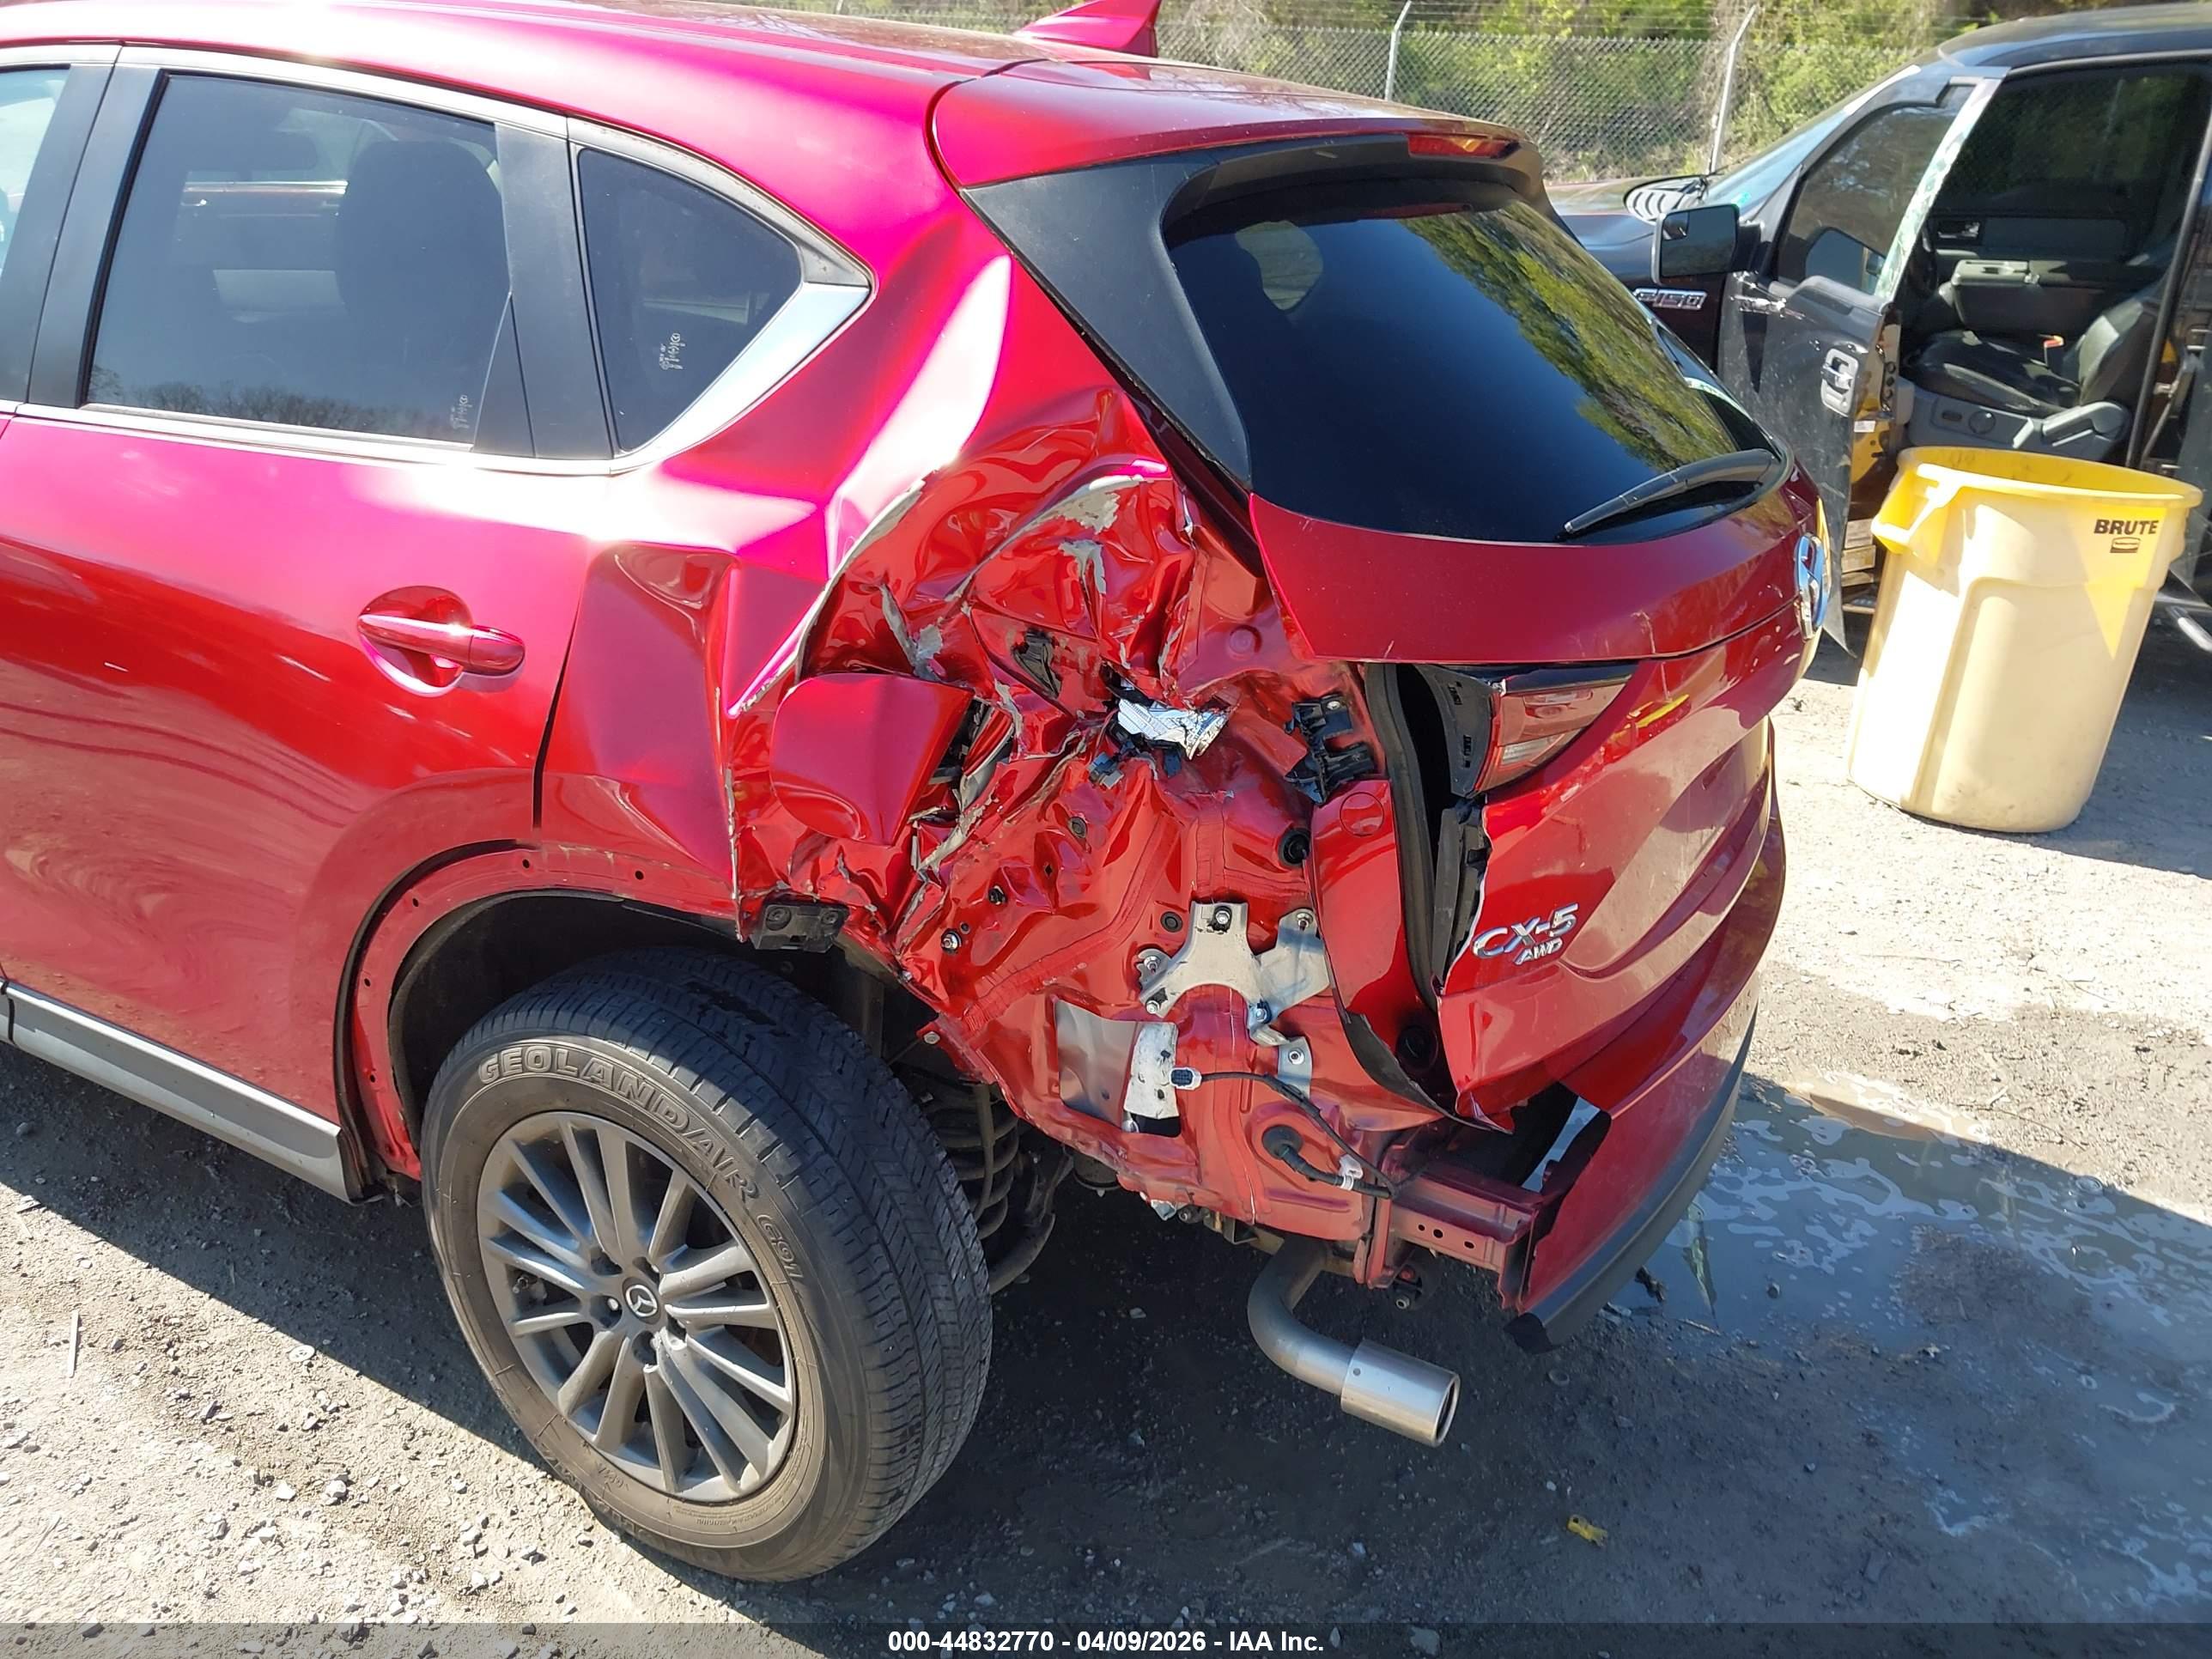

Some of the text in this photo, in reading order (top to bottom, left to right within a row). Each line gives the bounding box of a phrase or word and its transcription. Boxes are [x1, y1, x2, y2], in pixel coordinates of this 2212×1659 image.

[2094, 519, 2160, 535] BRUTE
[1472, 902, 1579, 959] CX-5
[1513, 937, 1563, 965] AWD
[477, 1044, 759, 1204] GEOLANDAR
